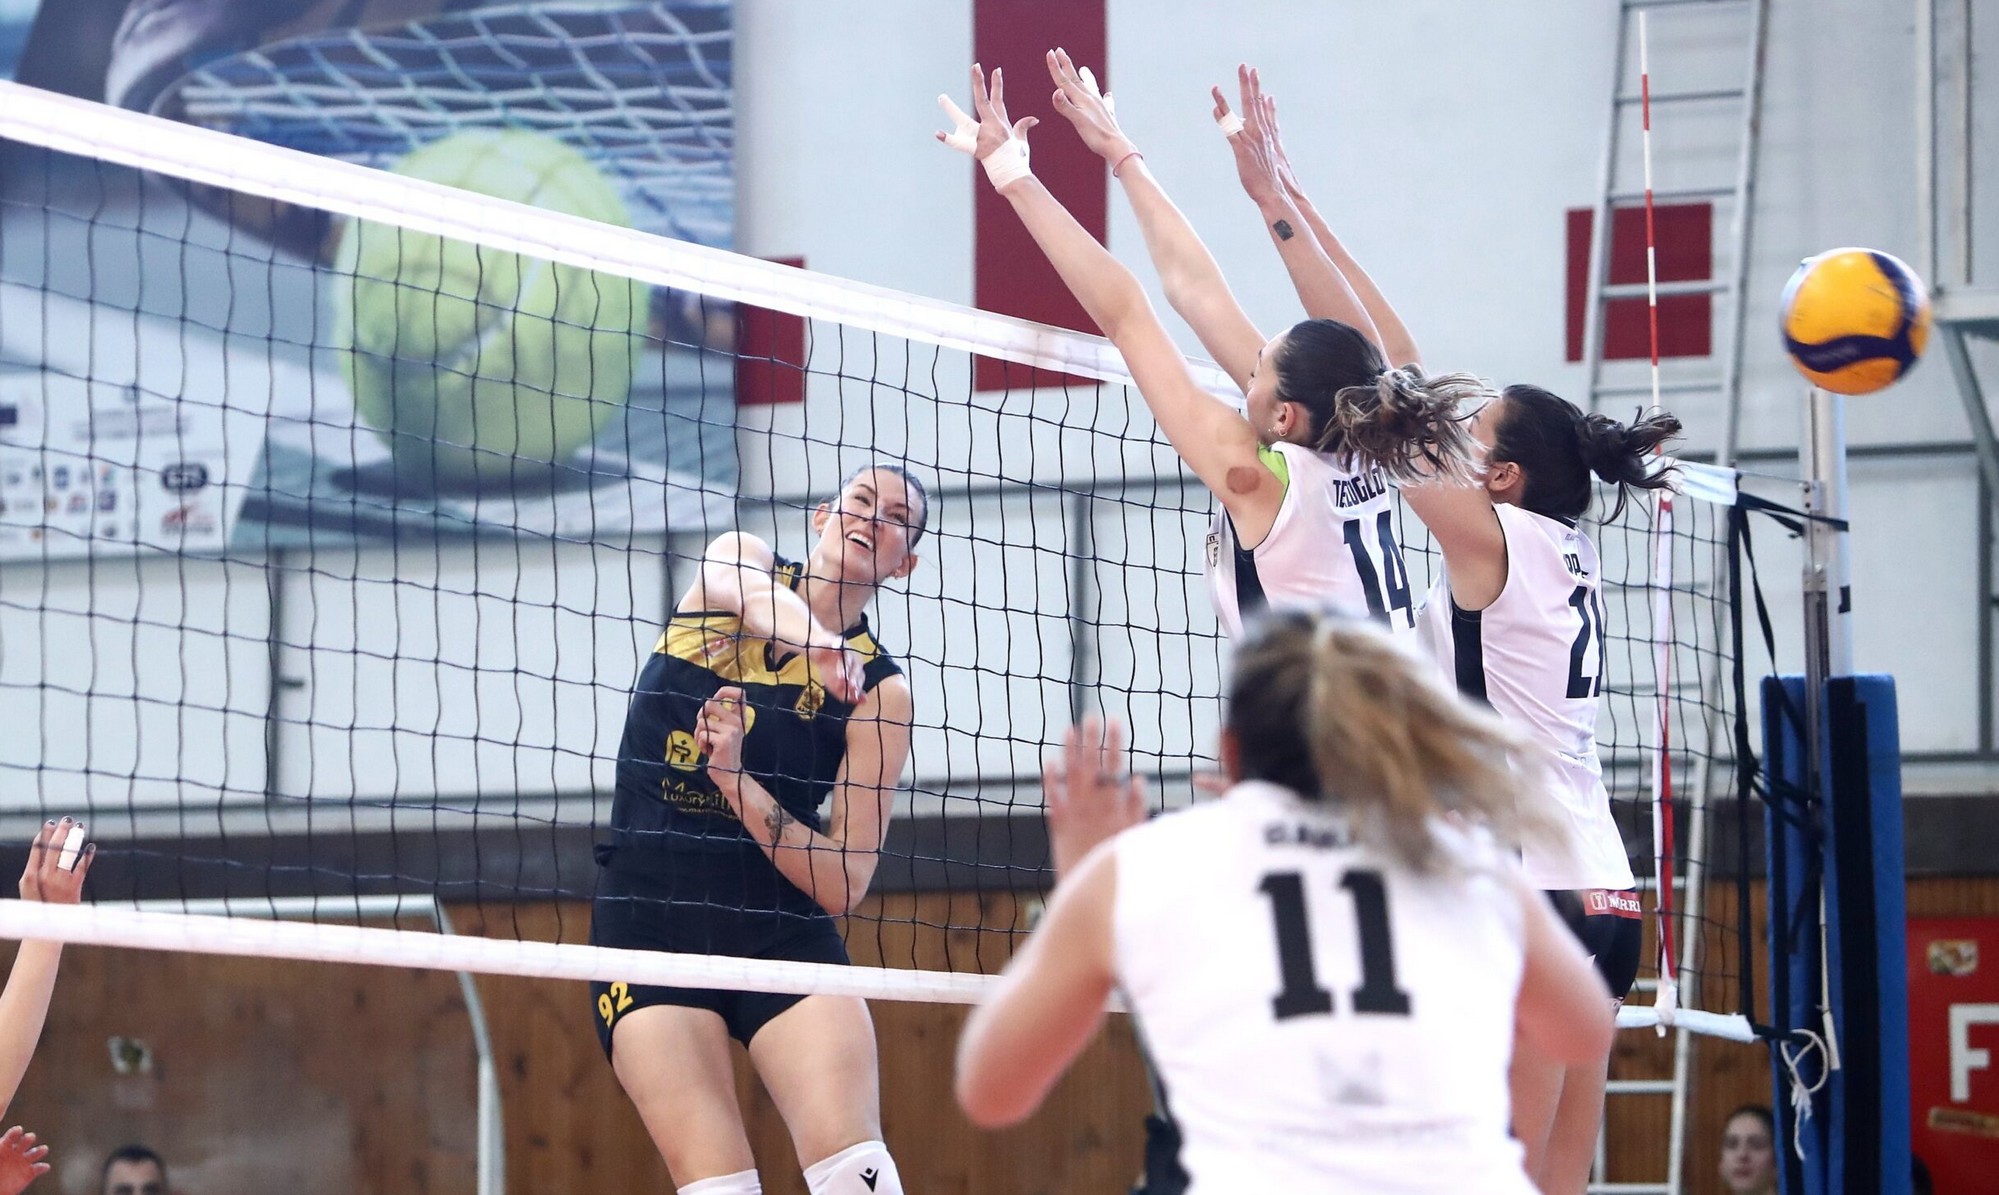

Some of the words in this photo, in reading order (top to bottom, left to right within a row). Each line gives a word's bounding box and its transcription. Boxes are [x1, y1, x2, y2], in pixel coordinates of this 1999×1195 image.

[1343, 510, 1415, 633] 14
[1258, 868, 1411, 1021] 11
[598, 981, 633, 1028] 92
[1949, 1004, 1999, 1102] F
